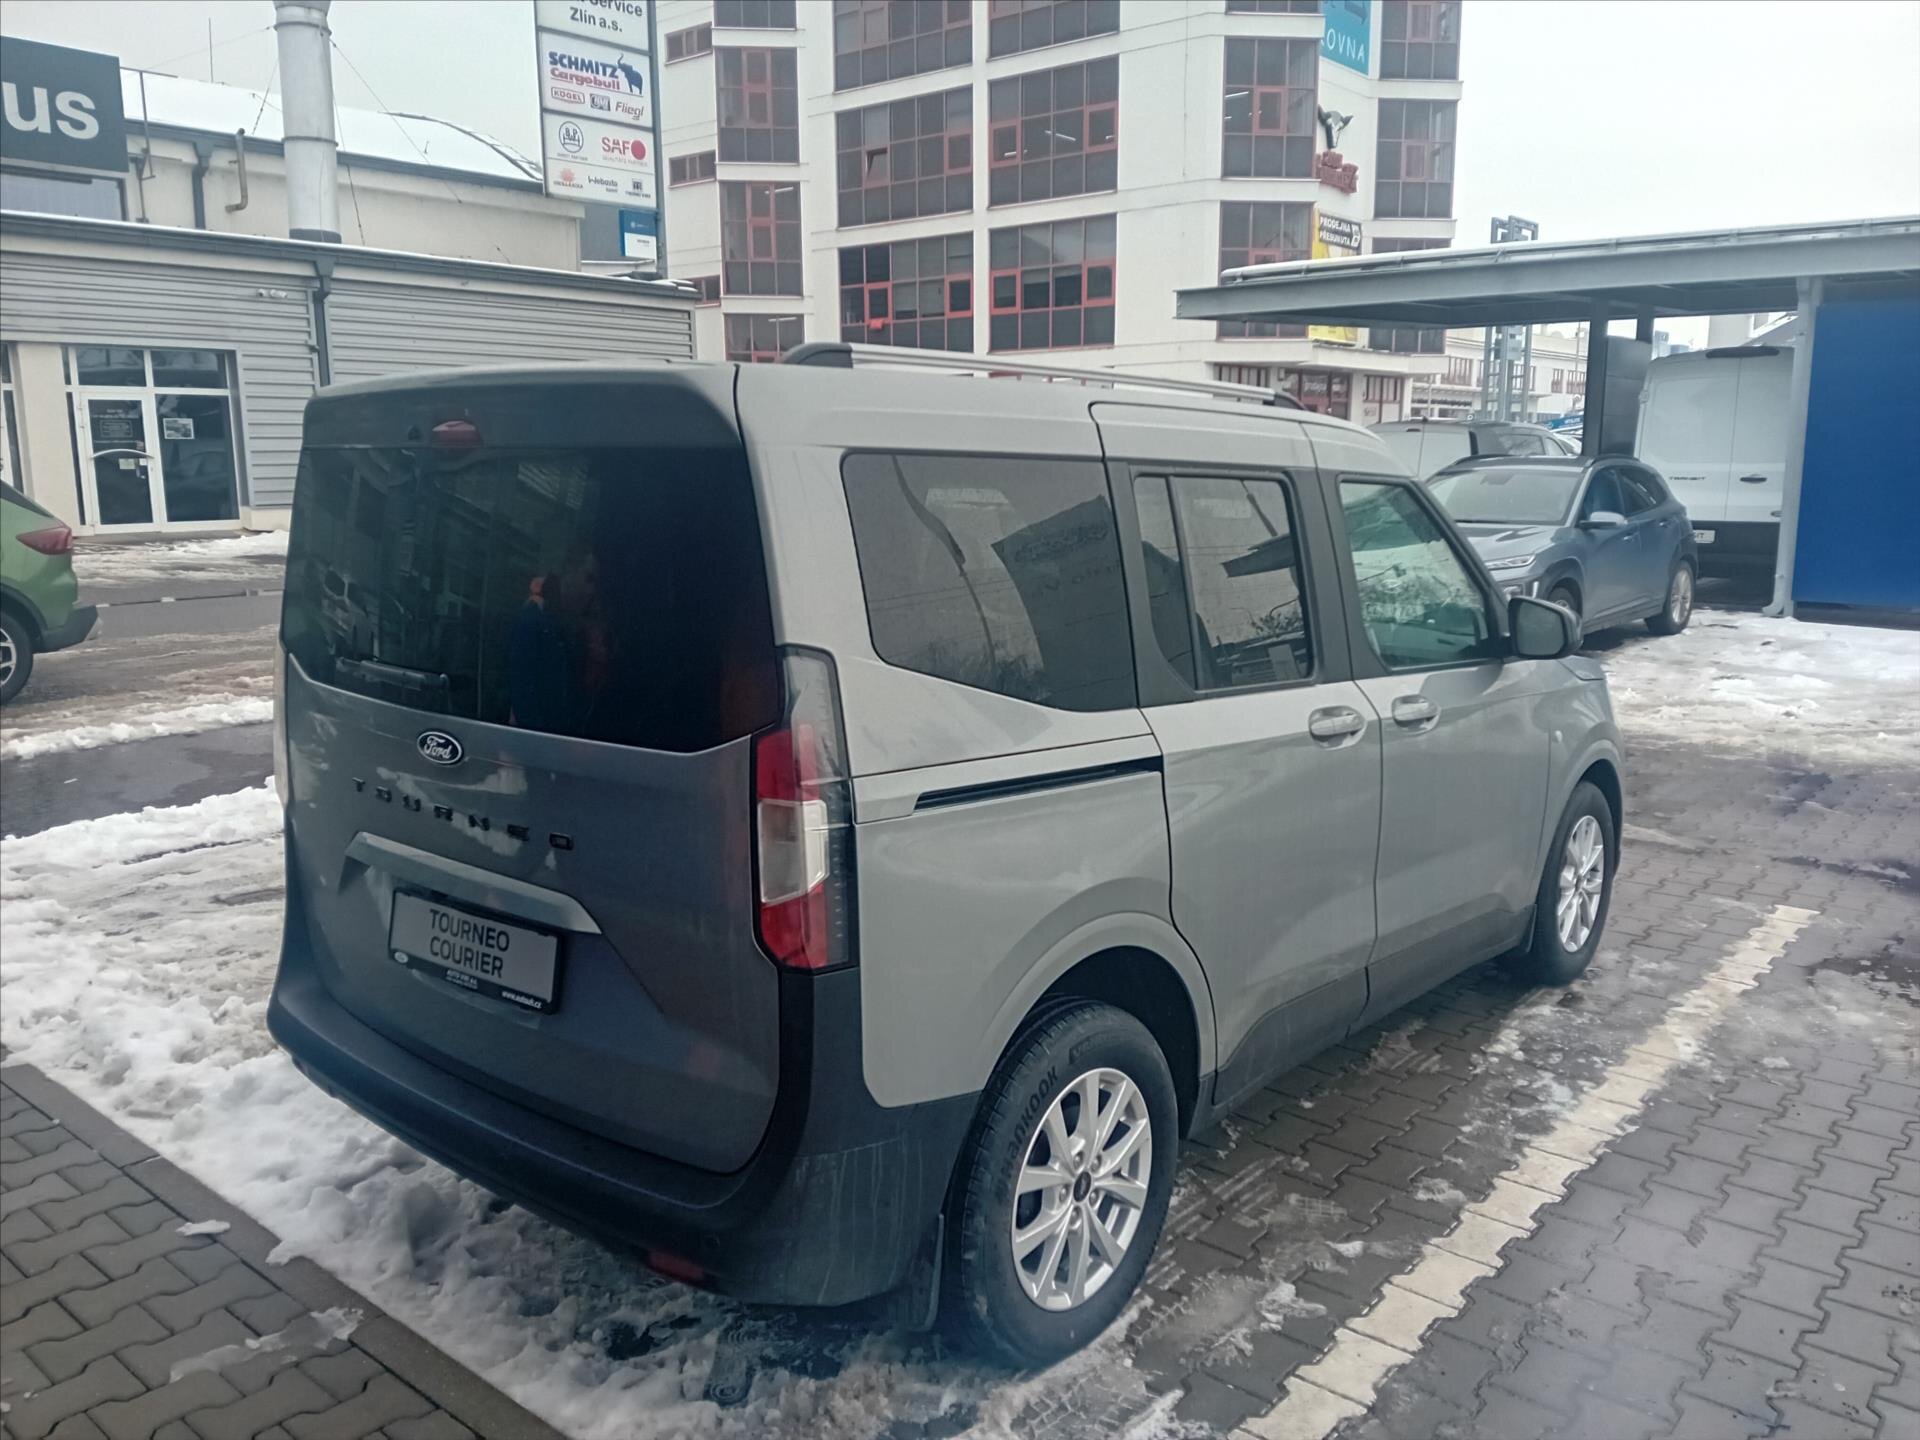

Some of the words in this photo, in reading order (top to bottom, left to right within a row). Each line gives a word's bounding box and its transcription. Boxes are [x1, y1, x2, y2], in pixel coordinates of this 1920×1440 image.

[599, 18, 623, 32] a.s.
[1321, 27, 1365, 64] OVNA
[548, 51, 619, 79] SCHMITZ
[550, 67, 621, 90] Cargobull
[2, 81, 99, 140] us
[424, 734, 454, 761] Ford
[352, 777, 575, 850] TOURNEO
[430, 908, 510, 953] TOURNEO
[430, 935, 504, 979] COURIER
